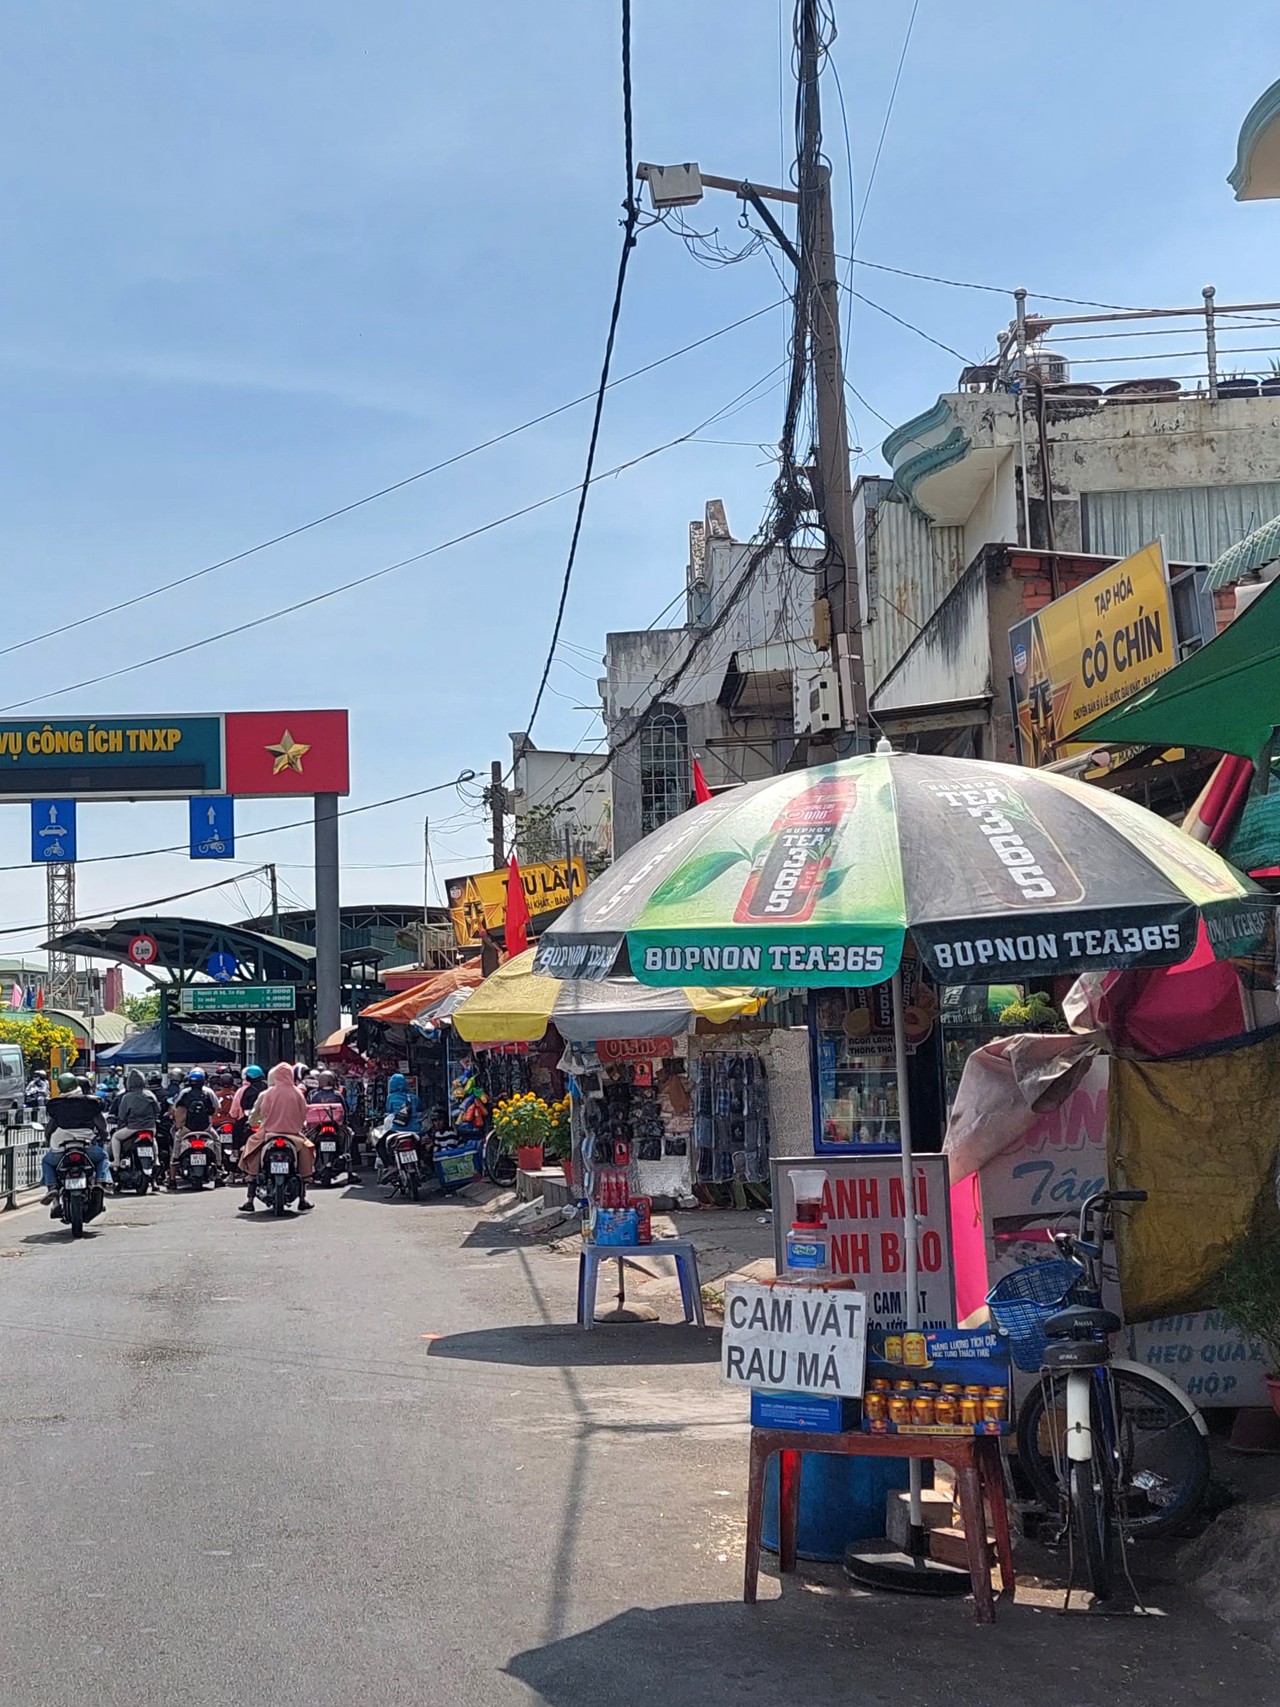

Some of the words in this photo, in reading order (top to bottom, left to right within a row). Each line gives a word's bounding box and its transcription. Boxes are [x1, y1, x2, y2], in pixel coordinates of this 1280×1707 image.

[1094, 590, 1111, 619] TẠP
[1112, 573, 1134, 605] HÓA
[1082, 632, 1108, 688] CÔ
[1113, 605, 1163, 672] CHÍN
[26, 725, 83, 754] CÔNG
[87, 724, 121, 753] ÍCH
[126, 729, 181, 752] TNXP
[936, 788, 1008, 807] TEA
[783, 835, 825, 847] TEA
[967, 805, 1057, 899] 365
[541, 865, 580, 893] LÂM
[765, 847, 808, 913] 365
[644, 945, 761, 971] BUPNON
[768, 945, 885, 971] TEA365
[934, 933, 1058, 968] BUPNON
[1063, 924, 1181, 957] TEA365
[821, 1178, 879, 1219] ANH
[889, 1168, 928, 1218] MÌ
[1013, 1160, 1106, 1206] Tân
[831, 1233, 870, 1274] NH
[730, 1295, 792, 1333] CAM
[802, 1295, 862, 1338] VẮT
[874, 1291, 902, 1314] CAM
[726, 1345, 787, 1384] RAU
[797, 1345, 841, 1389] MÁ
[1147, 1344, 1193, 1364] HEO
[1187, 1371, 1237, 1397] HỘP
